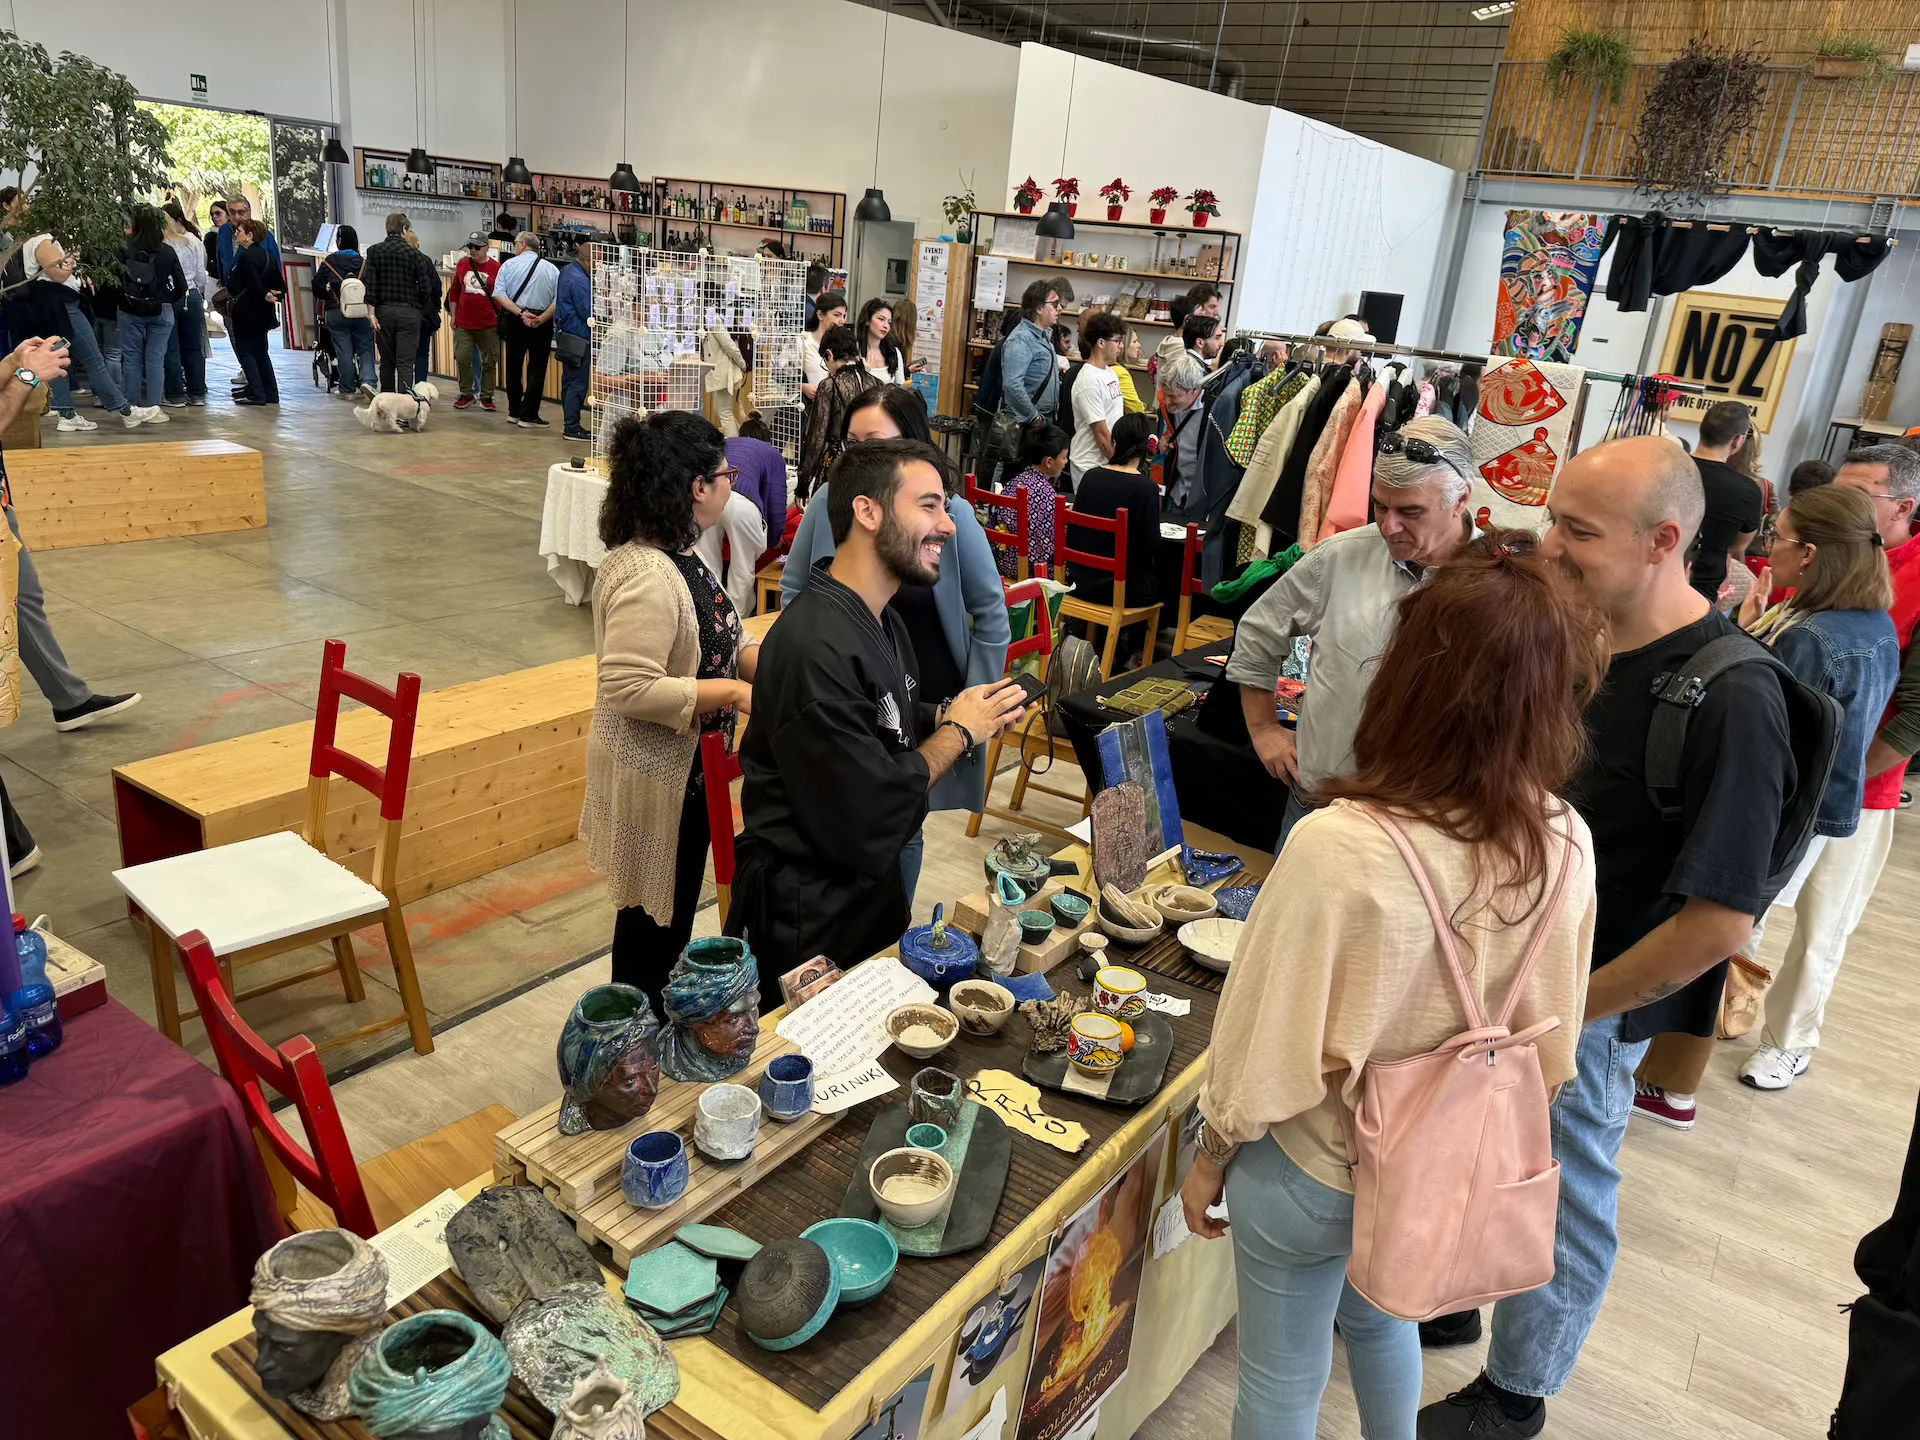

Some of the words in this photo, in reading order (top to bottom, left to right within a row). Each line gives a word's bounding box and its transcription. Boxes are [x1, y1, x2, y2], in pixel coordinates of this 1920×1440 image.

[925, 246, 944, 255] EVENTI
[1673, 310, 1778, 398] NOZ
[967, 1079, 1067, 1135] RAKU
[1037, 1358, 1114, 1440] SOLEDENTRO
[1080, 1390, 1097, 1411] Raku
